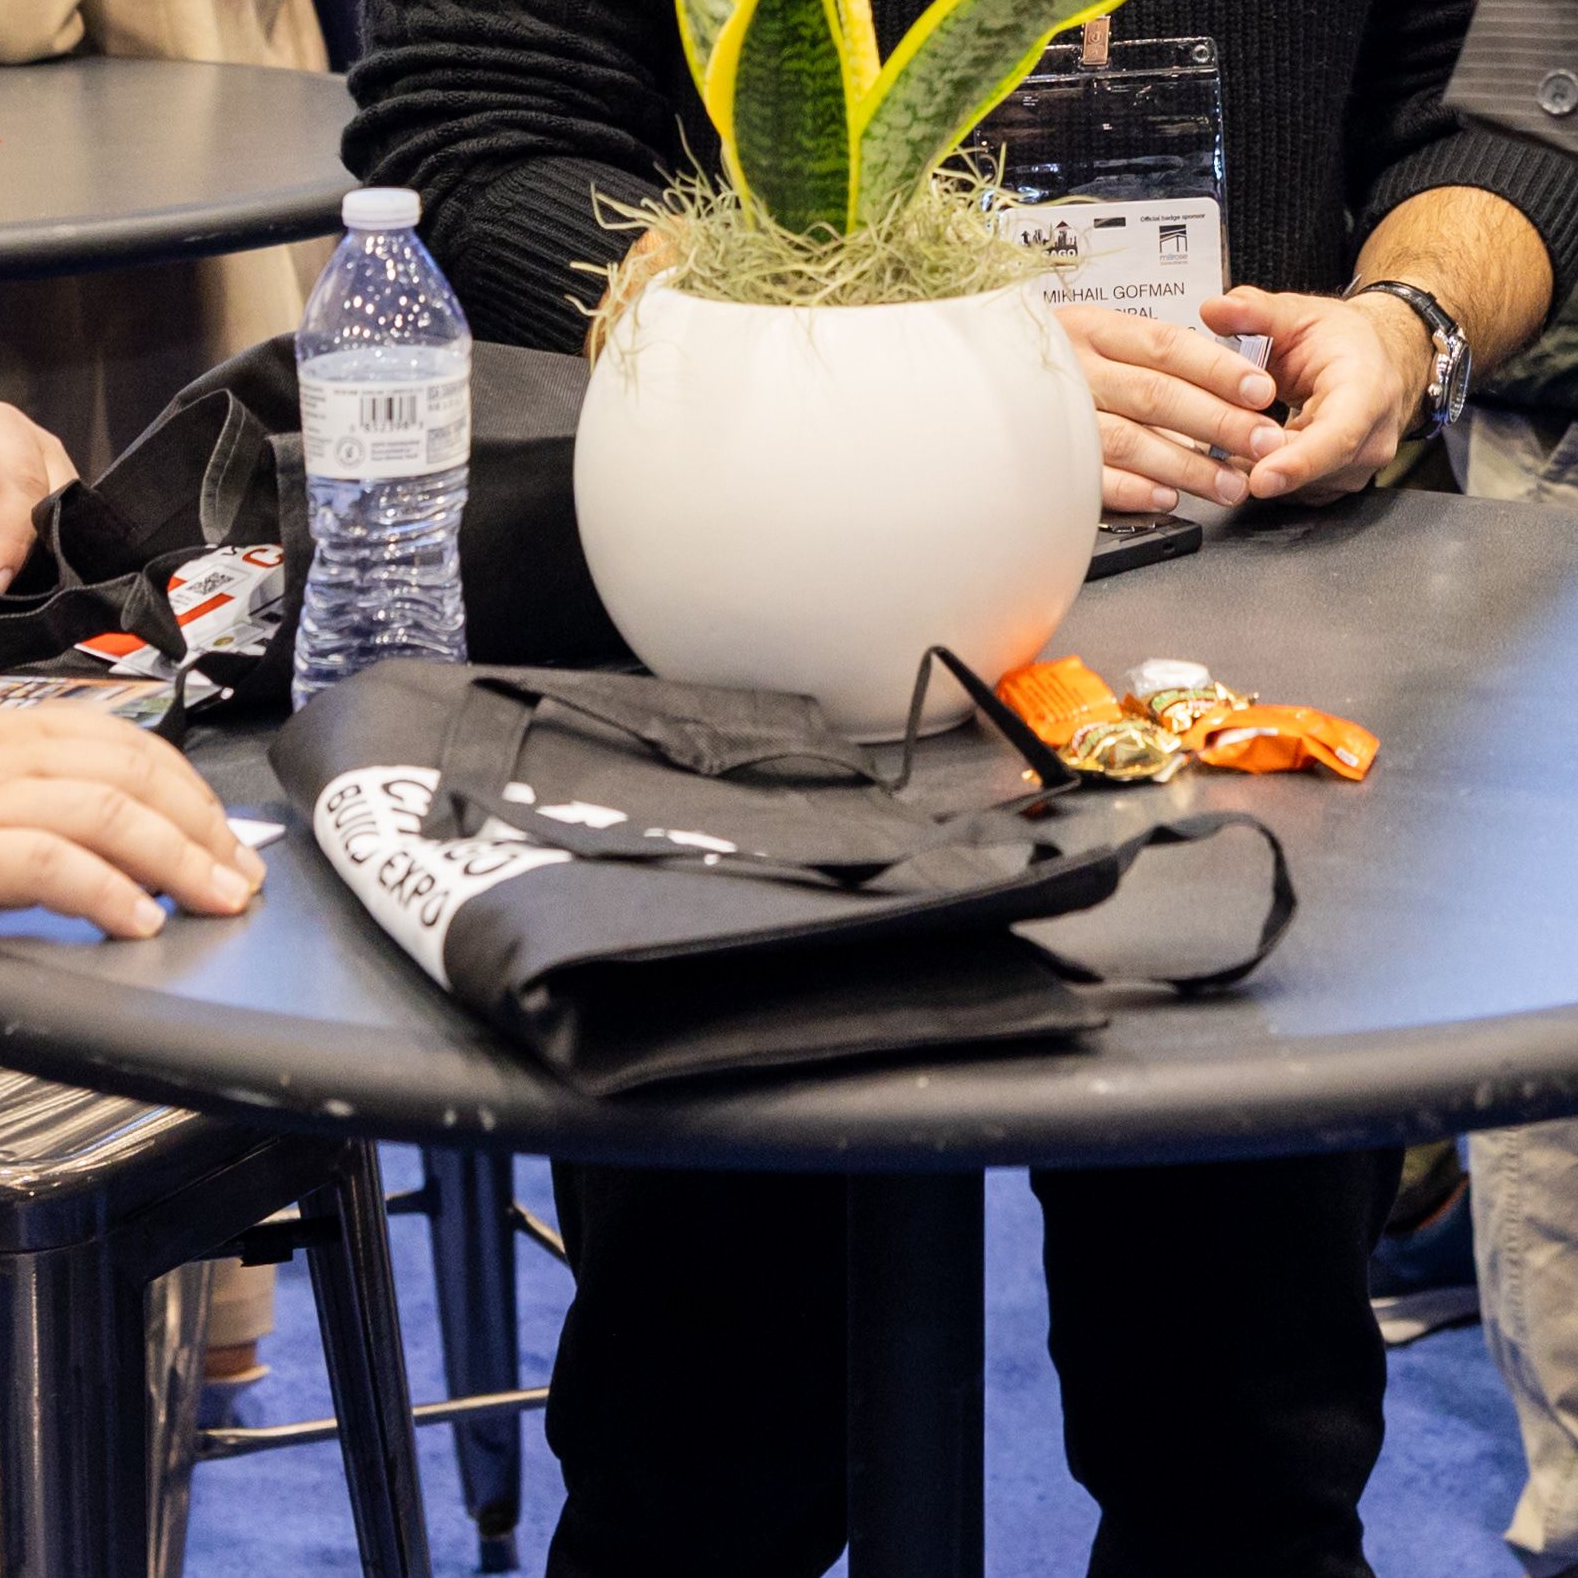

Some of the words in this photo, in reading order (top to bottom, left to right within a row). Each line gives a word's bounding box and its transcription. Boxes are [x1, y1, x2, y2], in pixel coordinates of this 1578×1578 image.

[1043, 288, 1109, 304] MIKHAIL
[1113, 282, 1185, 300] GOFMAN
[377, 850, 450, 927] EXPO
